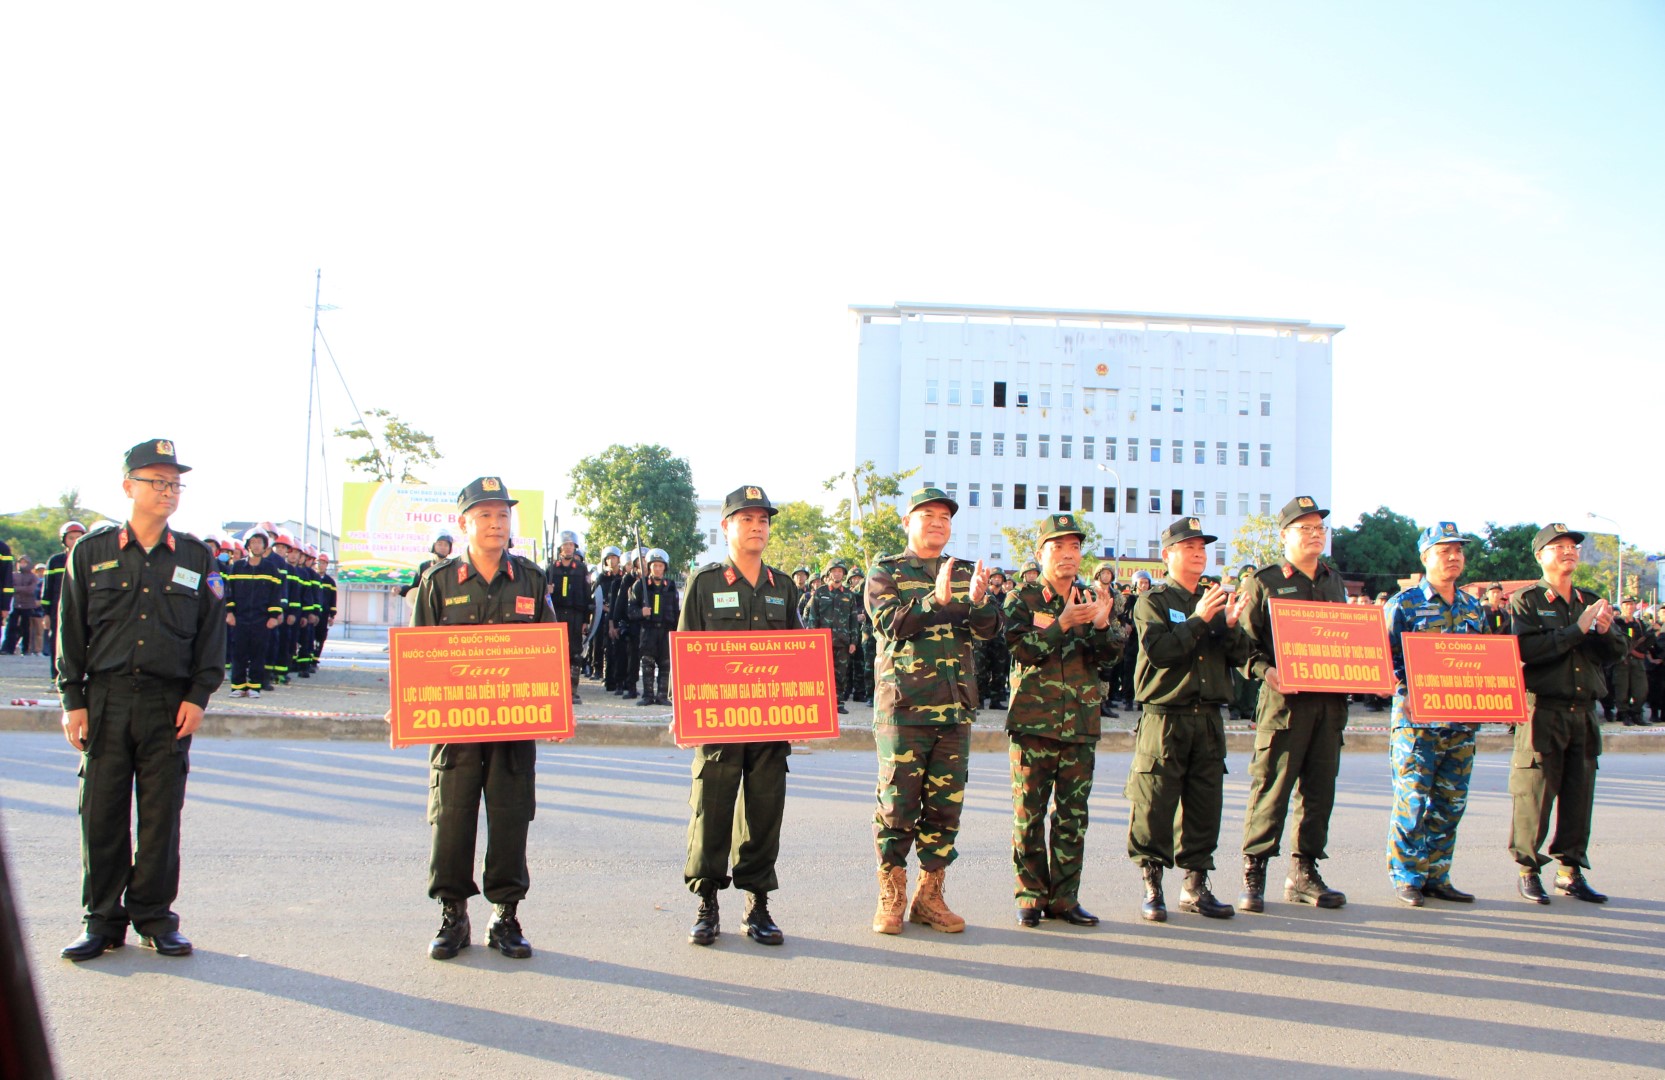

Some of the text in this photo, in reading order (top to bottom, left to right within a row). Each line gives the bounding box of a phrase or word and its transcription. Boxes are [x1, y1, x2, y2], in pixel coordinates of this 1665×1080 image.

[448, 632, 510, 646] BỘ QUỐC PHÒNG
[1435, 641, 1446, 652] BỘ
[1448, 641, 1472, 650] CÔNG
[426, 648, 448, 660] CỘNG
[468, 647, 484, 656] DÂN
[486, 646, 501, 656] CHỦ
[503, 645, 524, 655] NHÂN
[525, 645, 541, 654] DÂN
[687, 640, 816, 654] BỘ TƯ LỆNH QUÂN KHU 4
[452, 664, 511, 678] Tặng
[725, 661, 779, 676] Tặng
[1443, 657, 1481, 670] Tặng
[1291, 662, 1380, 681] 15.000.000đ
[403, 685, 417, 705] LỰC
[419, 685, 442, 704] LƯỢNG
[444, 685, 463, 701] THAM
[465, 685, 478, 700] GIA
[497, 681, 510, 701] TẬP
[512, 681, 530, 701] THỰC
[532, 682, 548, 697] BINH
[551, 682, 559, 696] A2
[684, 684, 696, 703] LỰC
[698, 683, 718, 703] LƯỢNG
[720, 683, 738, 699] THAM
[739, 683, 750, 699] GIA
[768, 680, 779, 701] TẬP
[781, 680, 798, 700] THỰC
[799, 682, 815, 696] BINH
[816, 681, 824, 696] A2
[1423, 694, 1513, 710] 20.000.000đ
[413, 704, 552, 729] 20.000.000đ
[693, 704, 818, 728] 15.000.000đ
